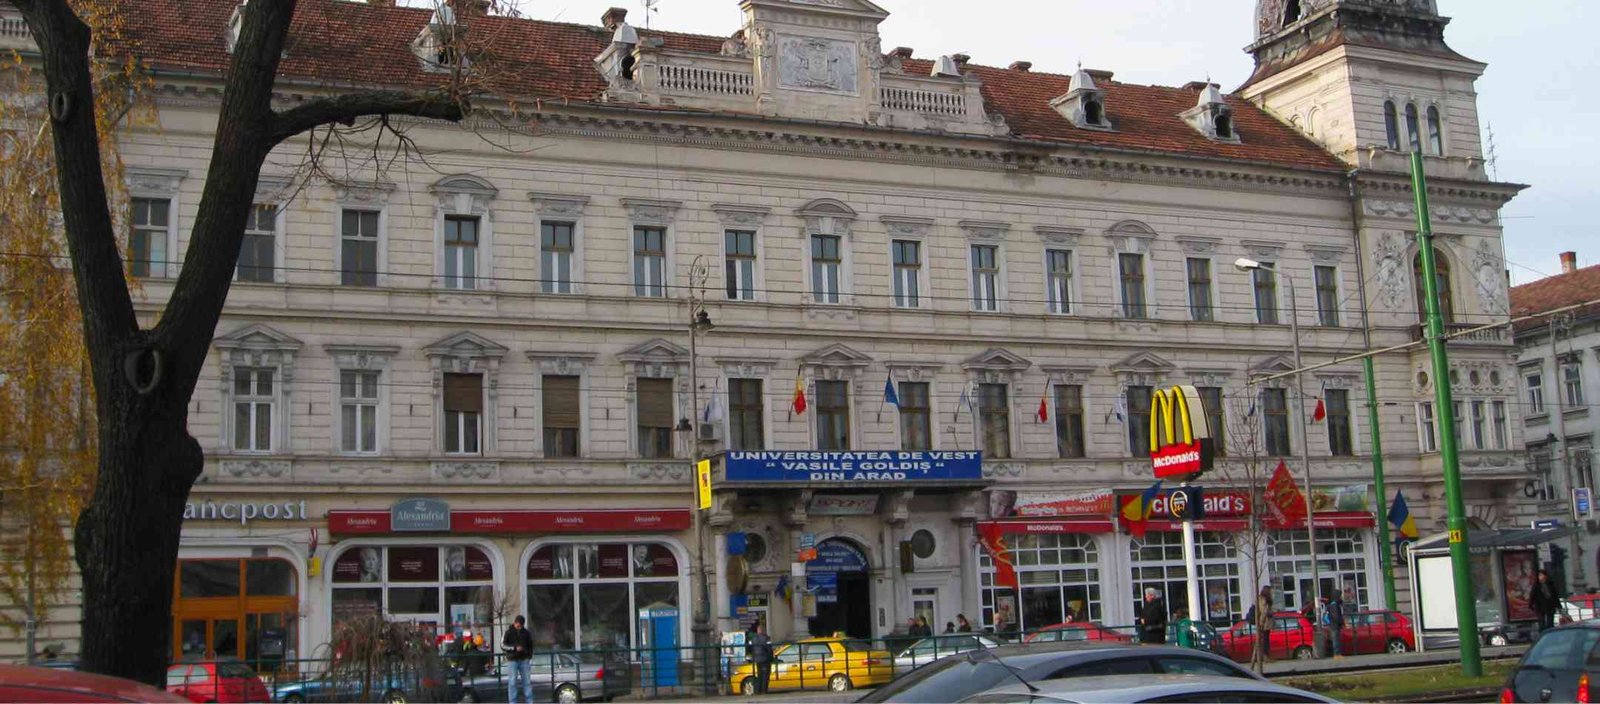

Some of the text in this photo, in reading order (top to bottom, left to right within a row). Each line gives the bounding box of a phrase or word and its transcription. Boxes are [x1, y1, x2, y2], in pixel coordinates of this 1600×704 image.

[729, 451, 978, 460] UNIVERSITATEA DE VEST
[1153, 450, 1200, 468] McDonald's
[781, 462, 853, 470] VASILE
[853, 472, 907, 480] ARAD
[183, 499, 308, 526] ancpost
[1027, 524, 1064, 532] McDonald's
